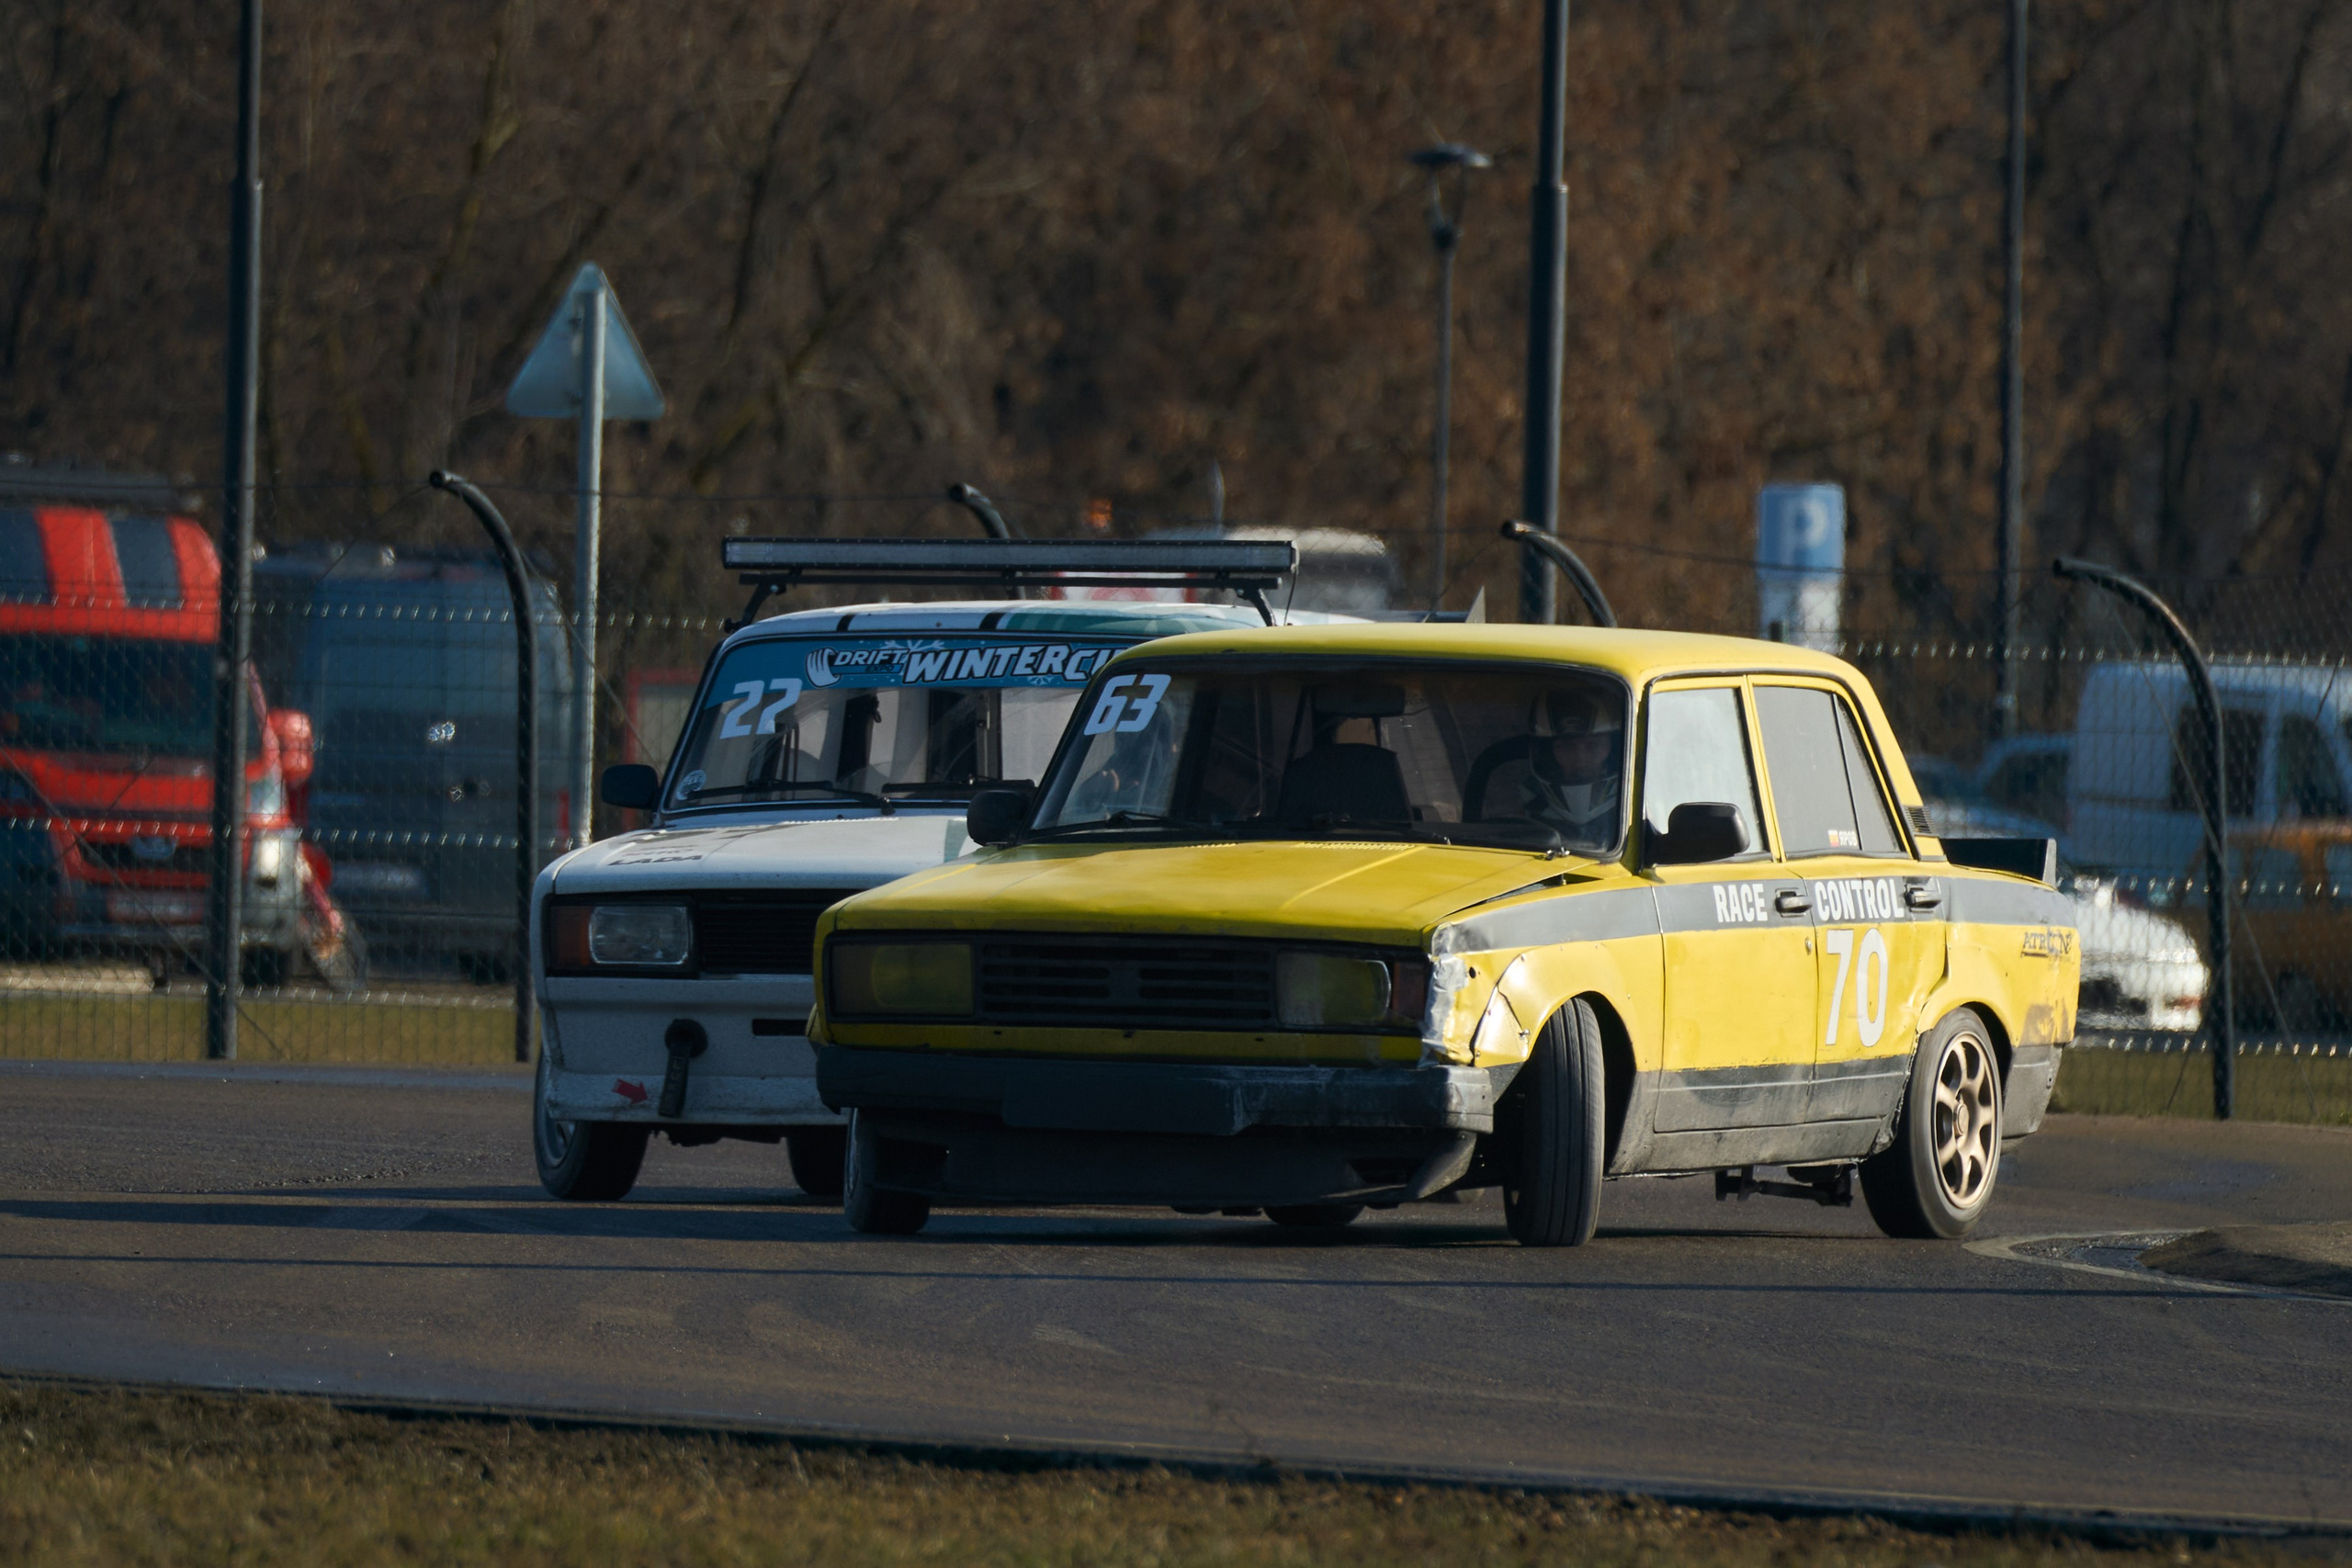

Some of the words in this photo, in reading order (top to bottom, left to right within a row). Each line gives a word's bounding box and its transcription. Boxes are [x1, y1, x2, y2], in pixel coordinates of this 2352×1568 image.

[833, 649, 910, 666] DRIFT
[719, 678, 803, 739] 22
[1084, 674, 1171, 735] 63
[607, 854, 703, 866] LADA
[1713, 883, 1768, 922] RACE
[1814, 878, 1905, 921] CONTROL
[1825, 928, 1889, 1047] 70
